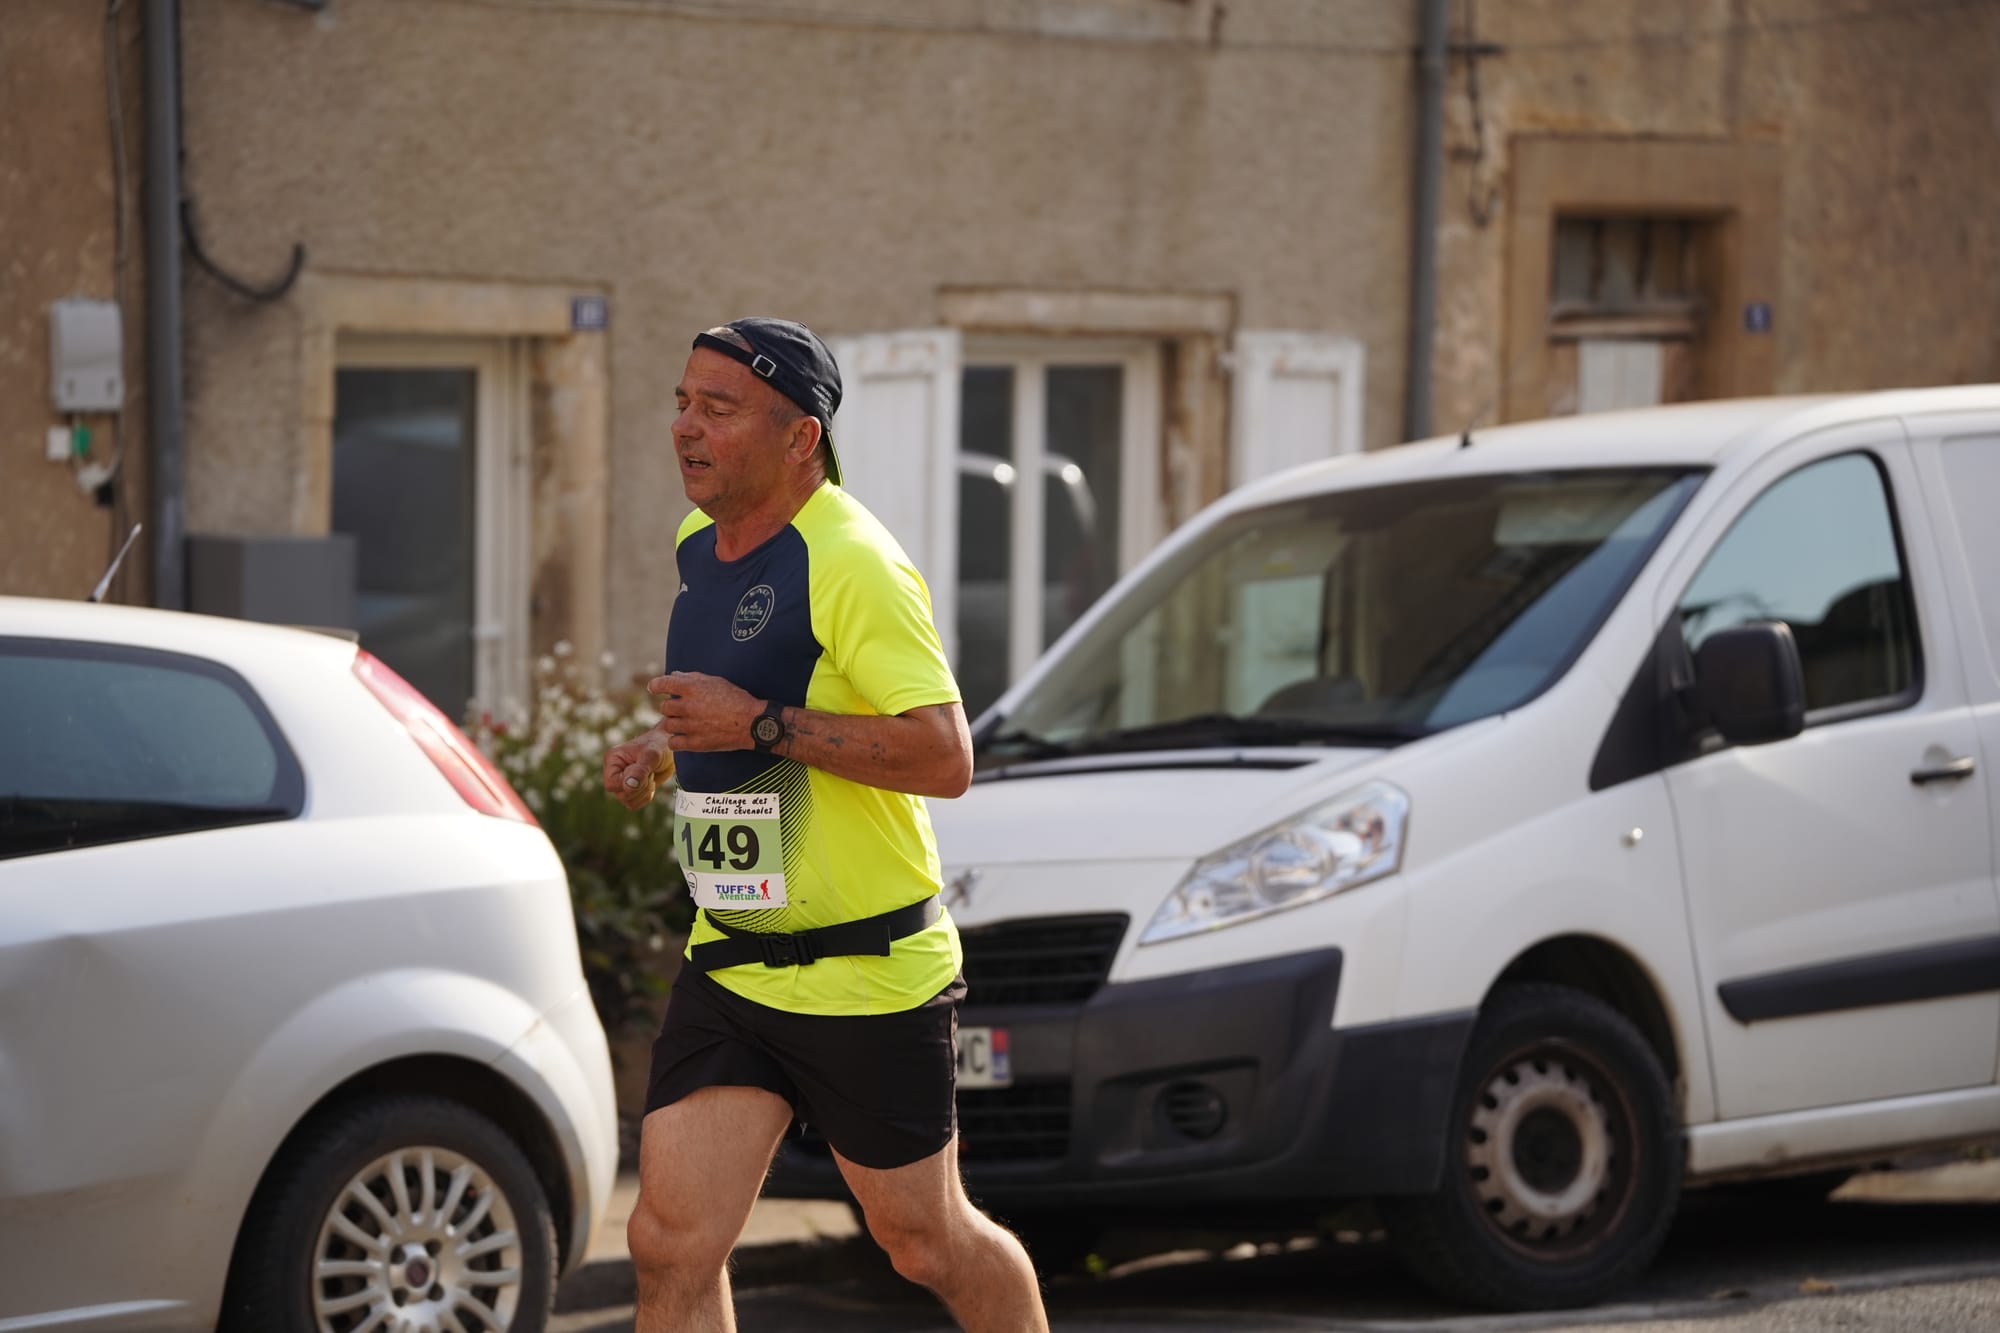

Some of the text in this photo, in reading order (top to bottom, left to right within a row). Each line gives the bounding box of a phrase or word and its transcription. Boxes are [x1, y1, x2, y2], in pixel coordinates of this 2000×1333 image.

[705, 796, 768, 808] Challenge des
[733, 806, 773, 815] cévenoles
[681, 822, 760, 871] 149
[714, 884, 756, 894] TUFF'S
[718, 891, 761, 901] Aventure
